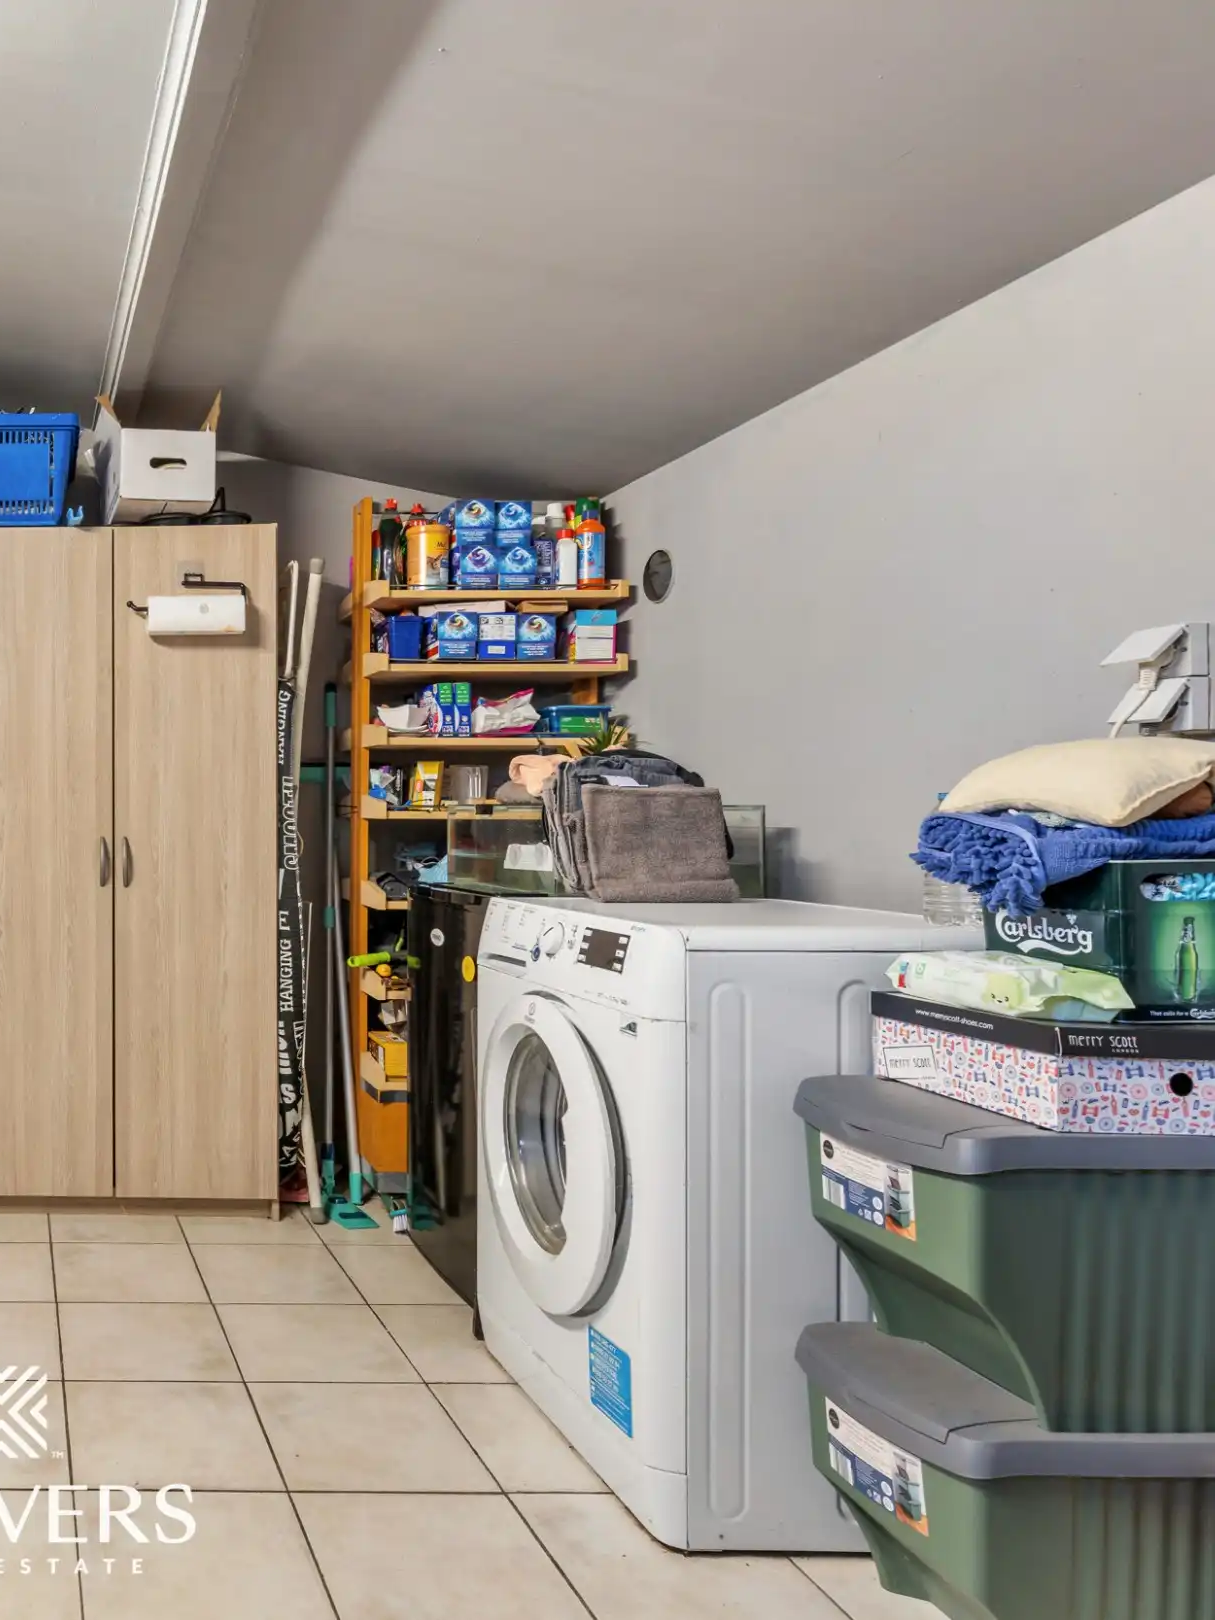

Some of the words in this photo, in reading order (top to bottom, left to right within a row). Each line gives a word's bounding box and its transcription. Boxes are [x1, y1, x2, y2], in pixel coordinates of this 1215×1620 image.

[995, 908, 1093, 953] Carlsberg
[279, 939, 294, 1012] HANGING
[915, 1008, 994, 1031] www.merryscott-shoes.com
